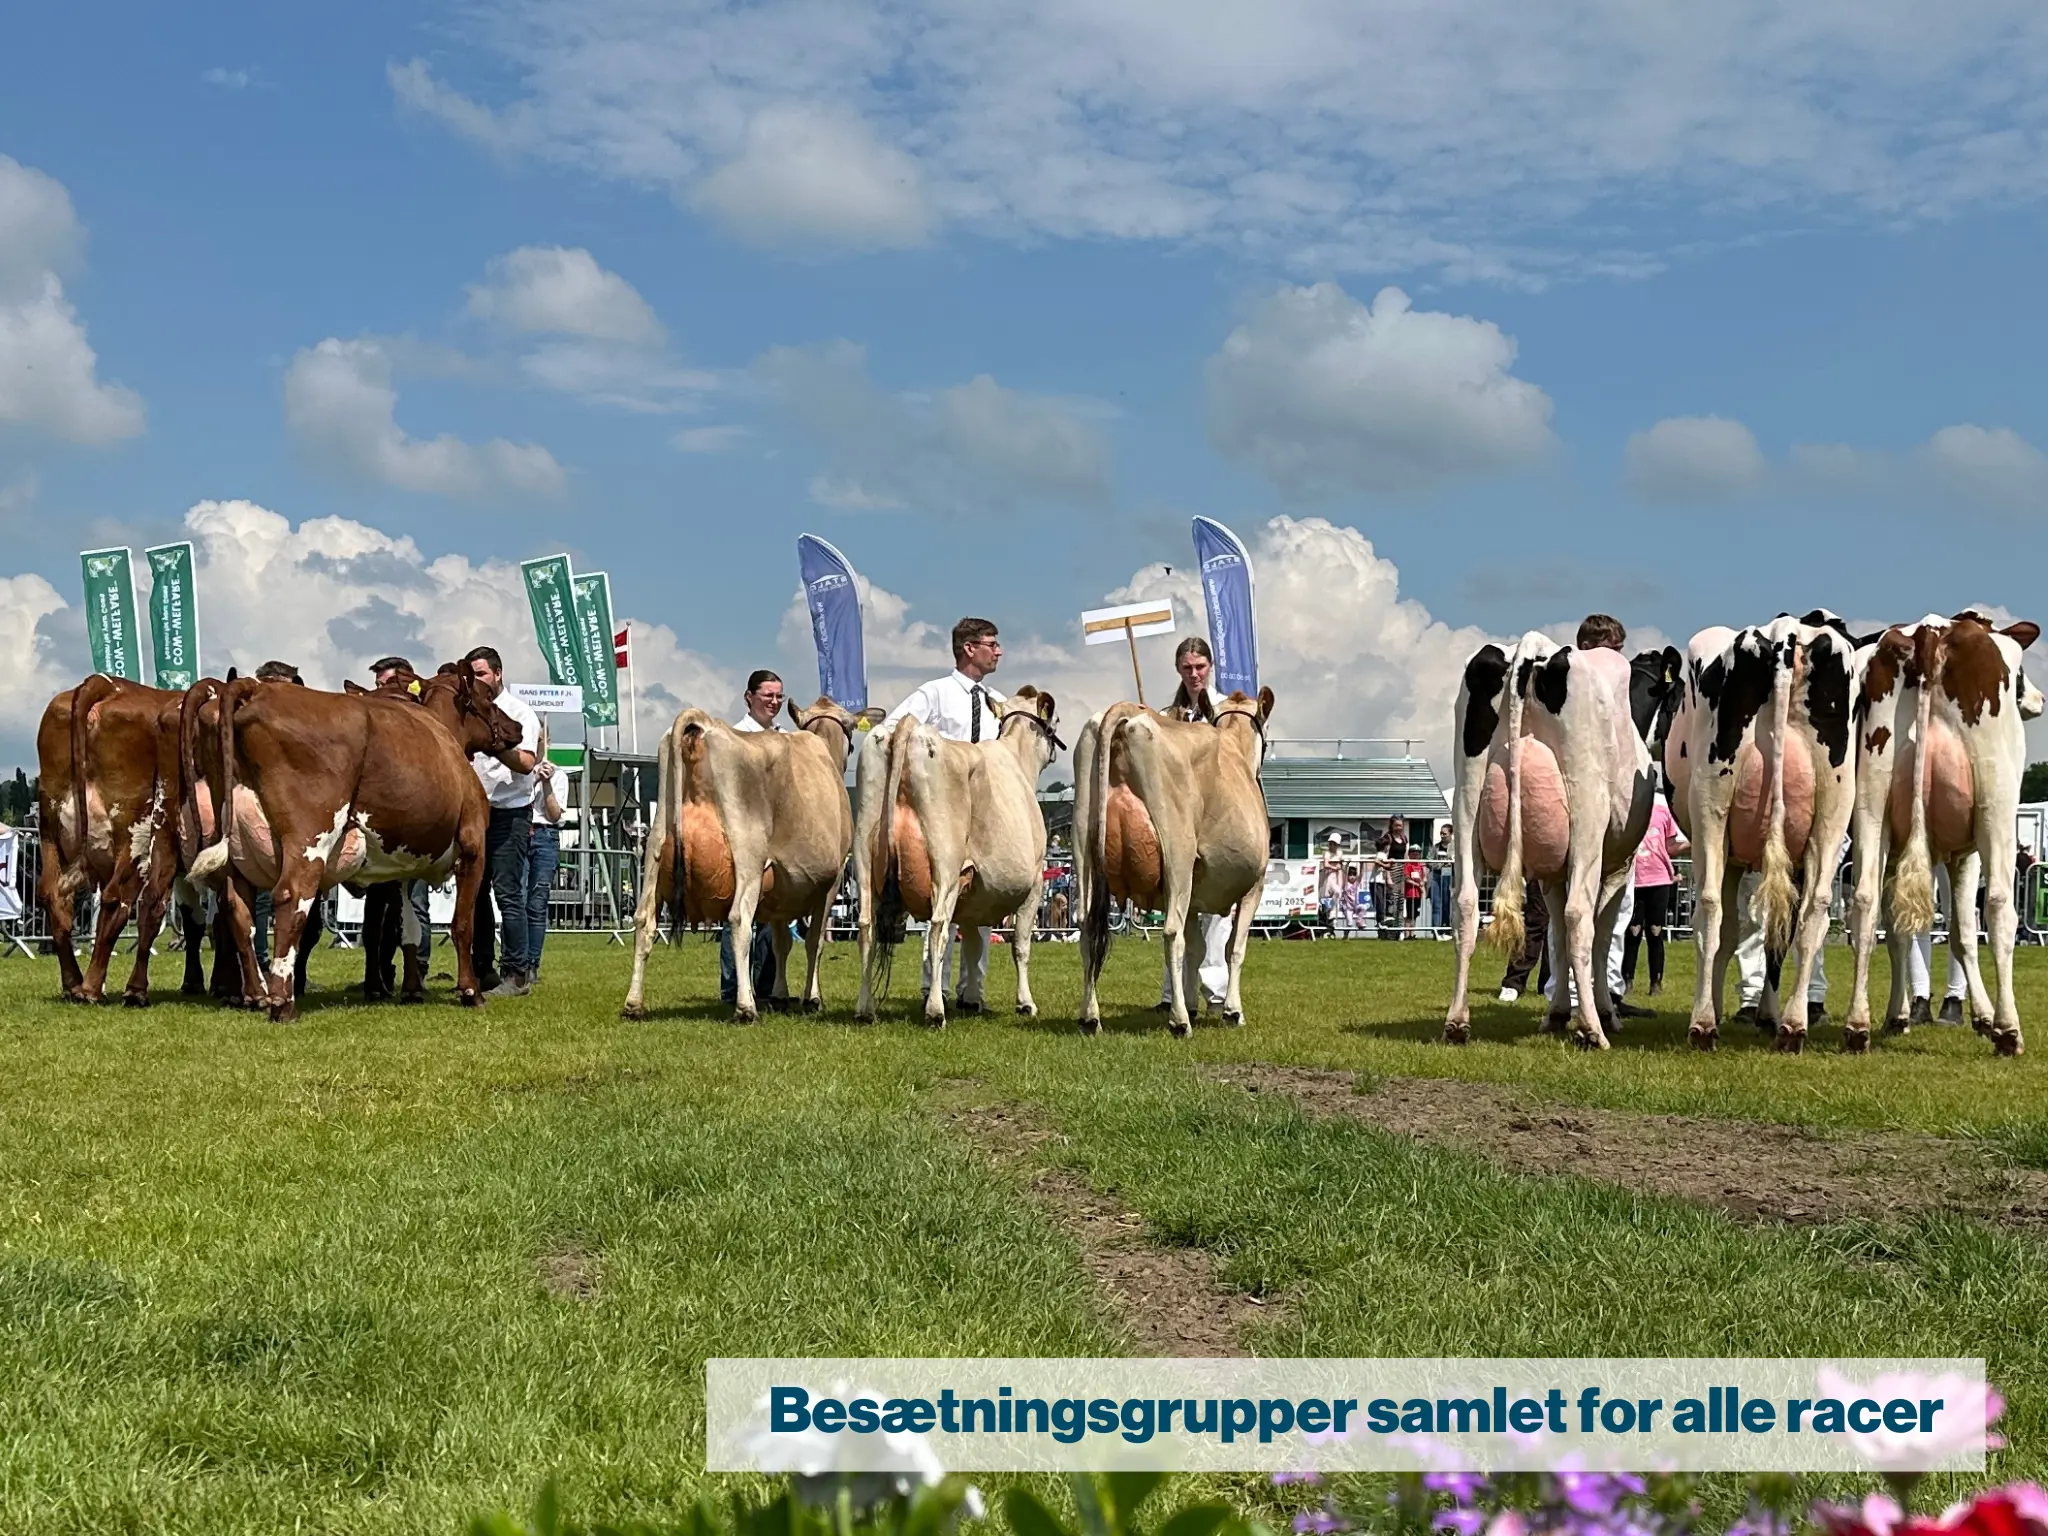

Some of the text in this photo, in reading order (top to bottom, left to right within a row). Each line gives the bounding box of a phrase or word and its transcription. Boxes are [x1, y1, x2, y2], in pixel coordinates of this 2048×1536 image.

[539, 689, 559, 697] PETER
[1265, 897, 1305, 907] maj 2025
